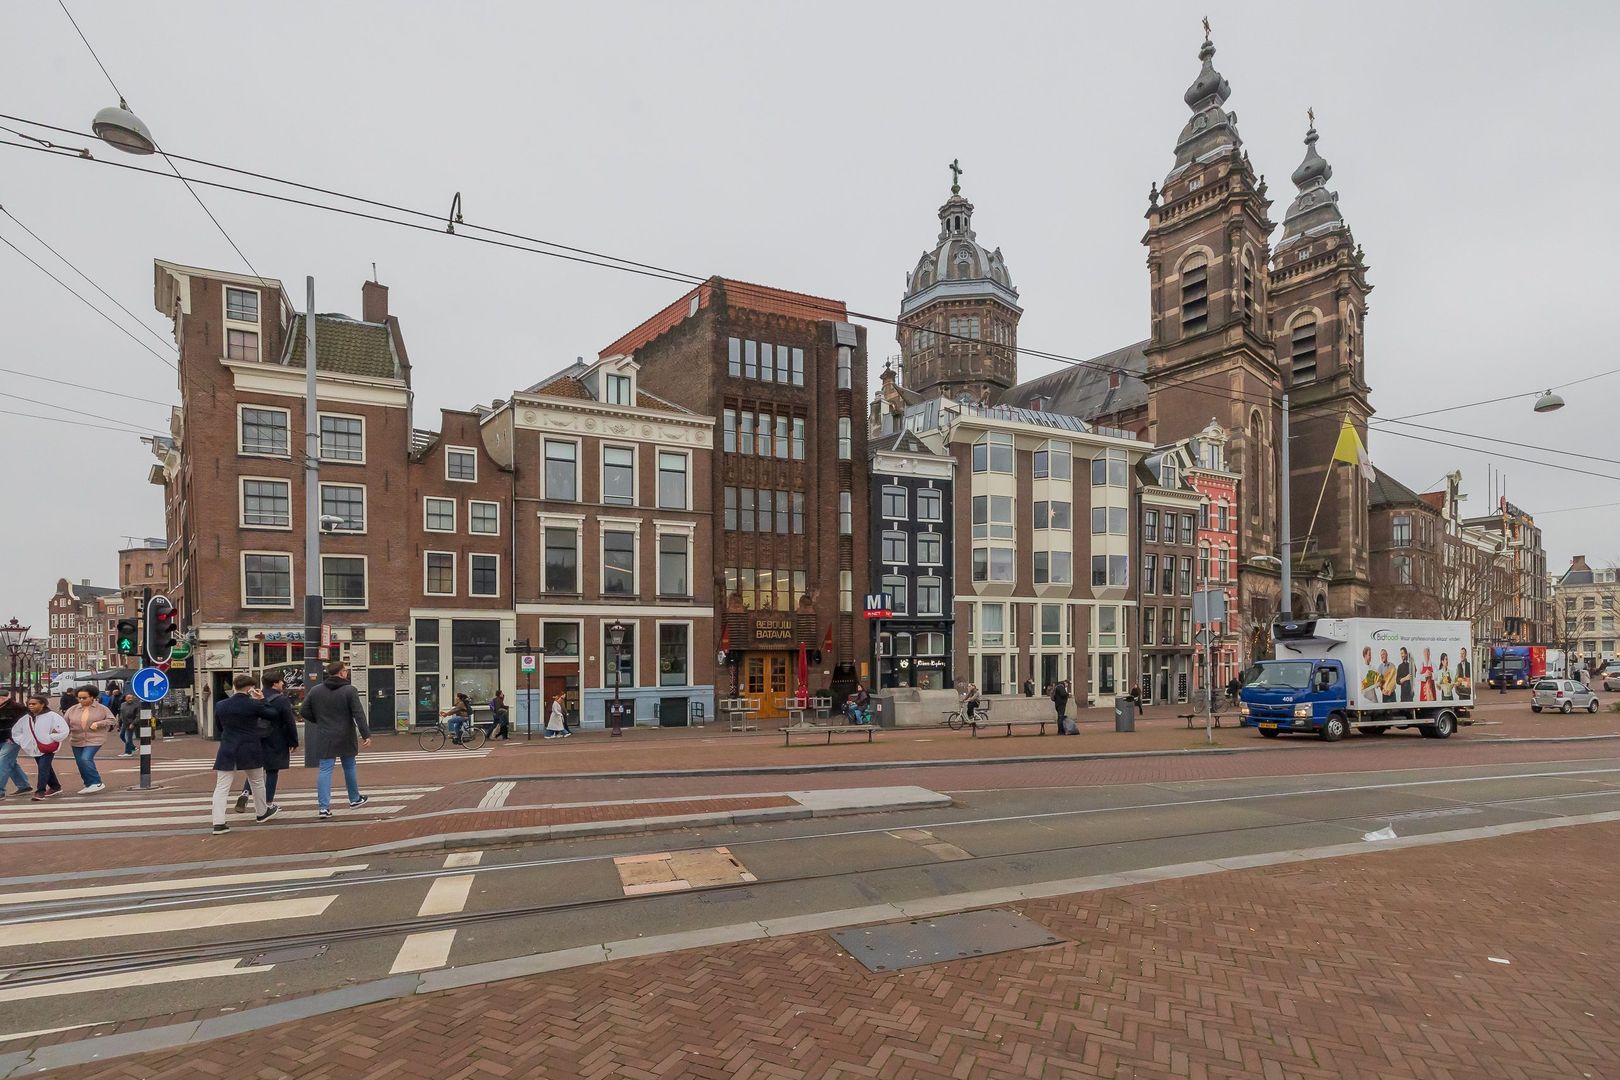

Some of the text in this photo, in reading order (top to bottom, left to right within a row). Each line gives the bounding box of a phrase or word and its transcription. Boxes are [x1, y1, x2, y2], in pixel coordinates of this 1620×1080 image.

[867, 595, 881, 610] M
[757, 630, 792, 639] BATAVIA
[1376, 633, 1398, 641] Bidfood
